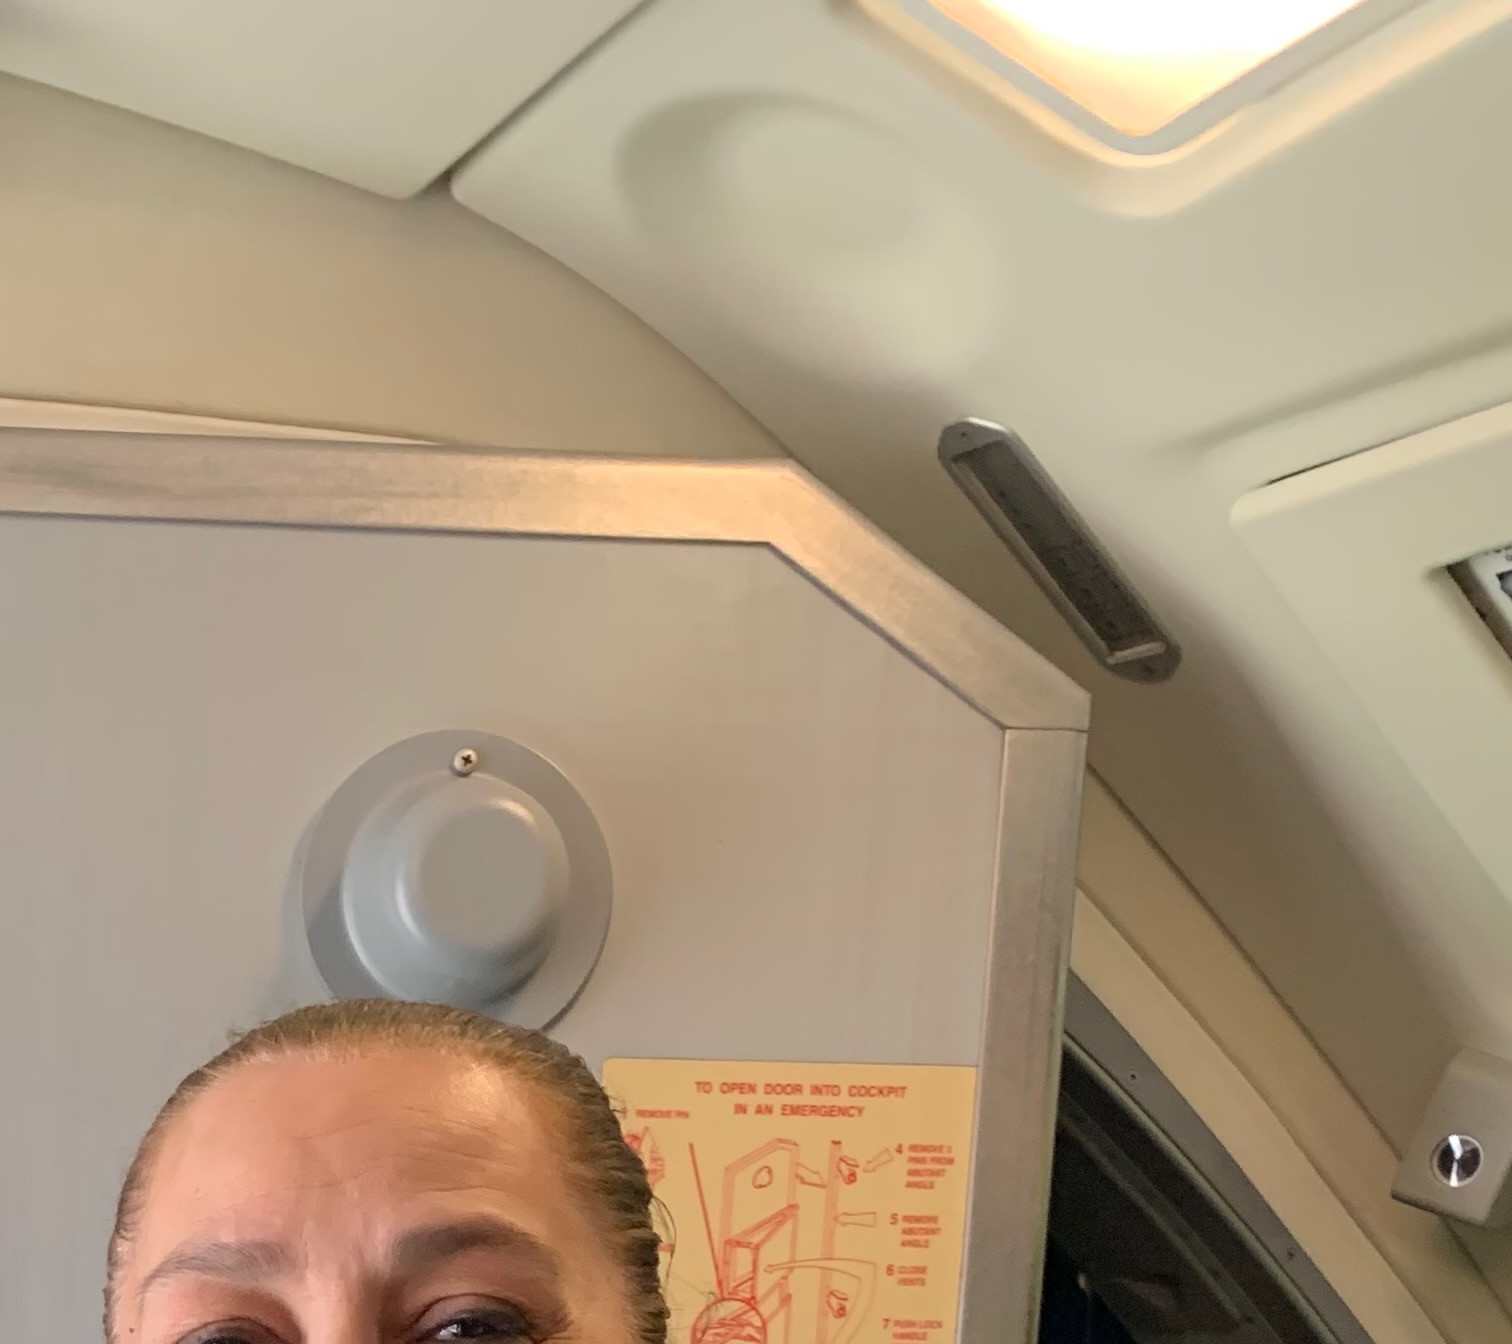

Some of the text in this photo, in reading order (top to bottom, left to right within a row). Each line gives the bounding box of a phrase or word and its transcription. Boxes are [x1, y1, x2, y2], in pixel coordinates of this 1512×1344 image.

[694, 1081, 907, 1099] TO OPEN DOOR INTO COCKPIT
[733, 1103, 865, 1118] IN AN EMERGENCY
[895, 1143, 903, 1155] 4
[890, 1213, 898, 1225] 5
[886, 1264, 895, 1276] 6
[883, 1318, 890, 1330] 7
